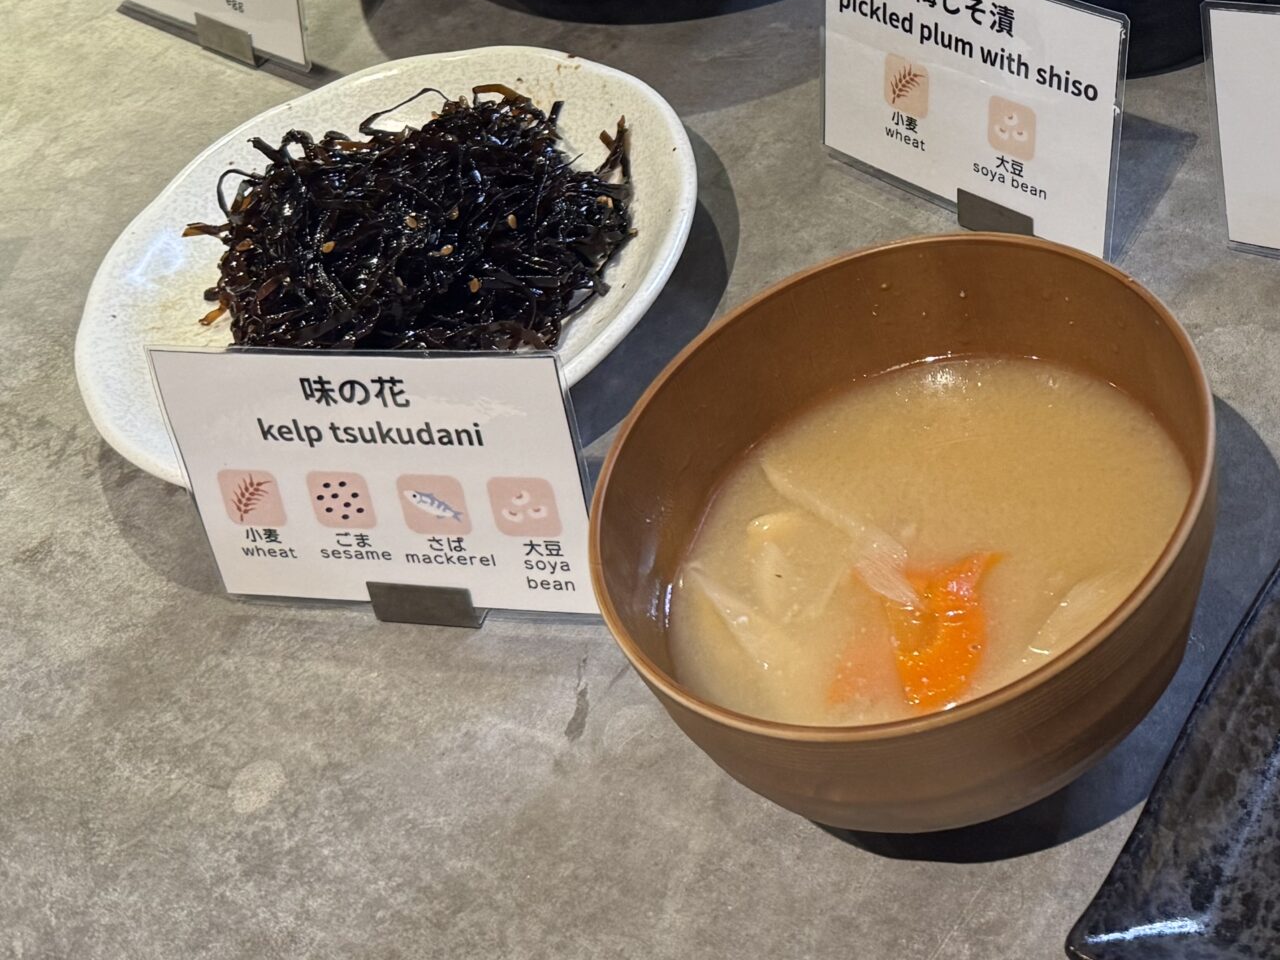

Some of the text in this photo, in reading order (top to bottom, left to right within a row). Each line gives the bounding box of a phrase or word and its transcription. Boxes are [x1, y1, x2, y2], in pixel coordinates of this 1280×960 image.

[919, 20, 974, 59] plum
[979, 43, 1030, 80] with
[1035, 65, 1099, 102] shiso
[891, 111, 918, 134] 小麦
[884, 125, 926, 152] wheat
[995, 155, 1024, 178] 大豆
[973, 161, 1047, 200] soya bean
[299, 376, 411, 409] 味の花
[256, 418, 485, 448] kelp tsukudani
[245, 528, 282, 545] 小麦
[335, 531, 373, 548] ごま
[427, 536, 467, 553] さば
[242, 545, 298, 559] wheat
[320, 548, 393, 562] sesame
[522, 540, 565, 558] 大豆
[405, 552, 497, 568] mackerel
[524, 558, 571, 574] soya
[527, 575, 576, 592] bean
